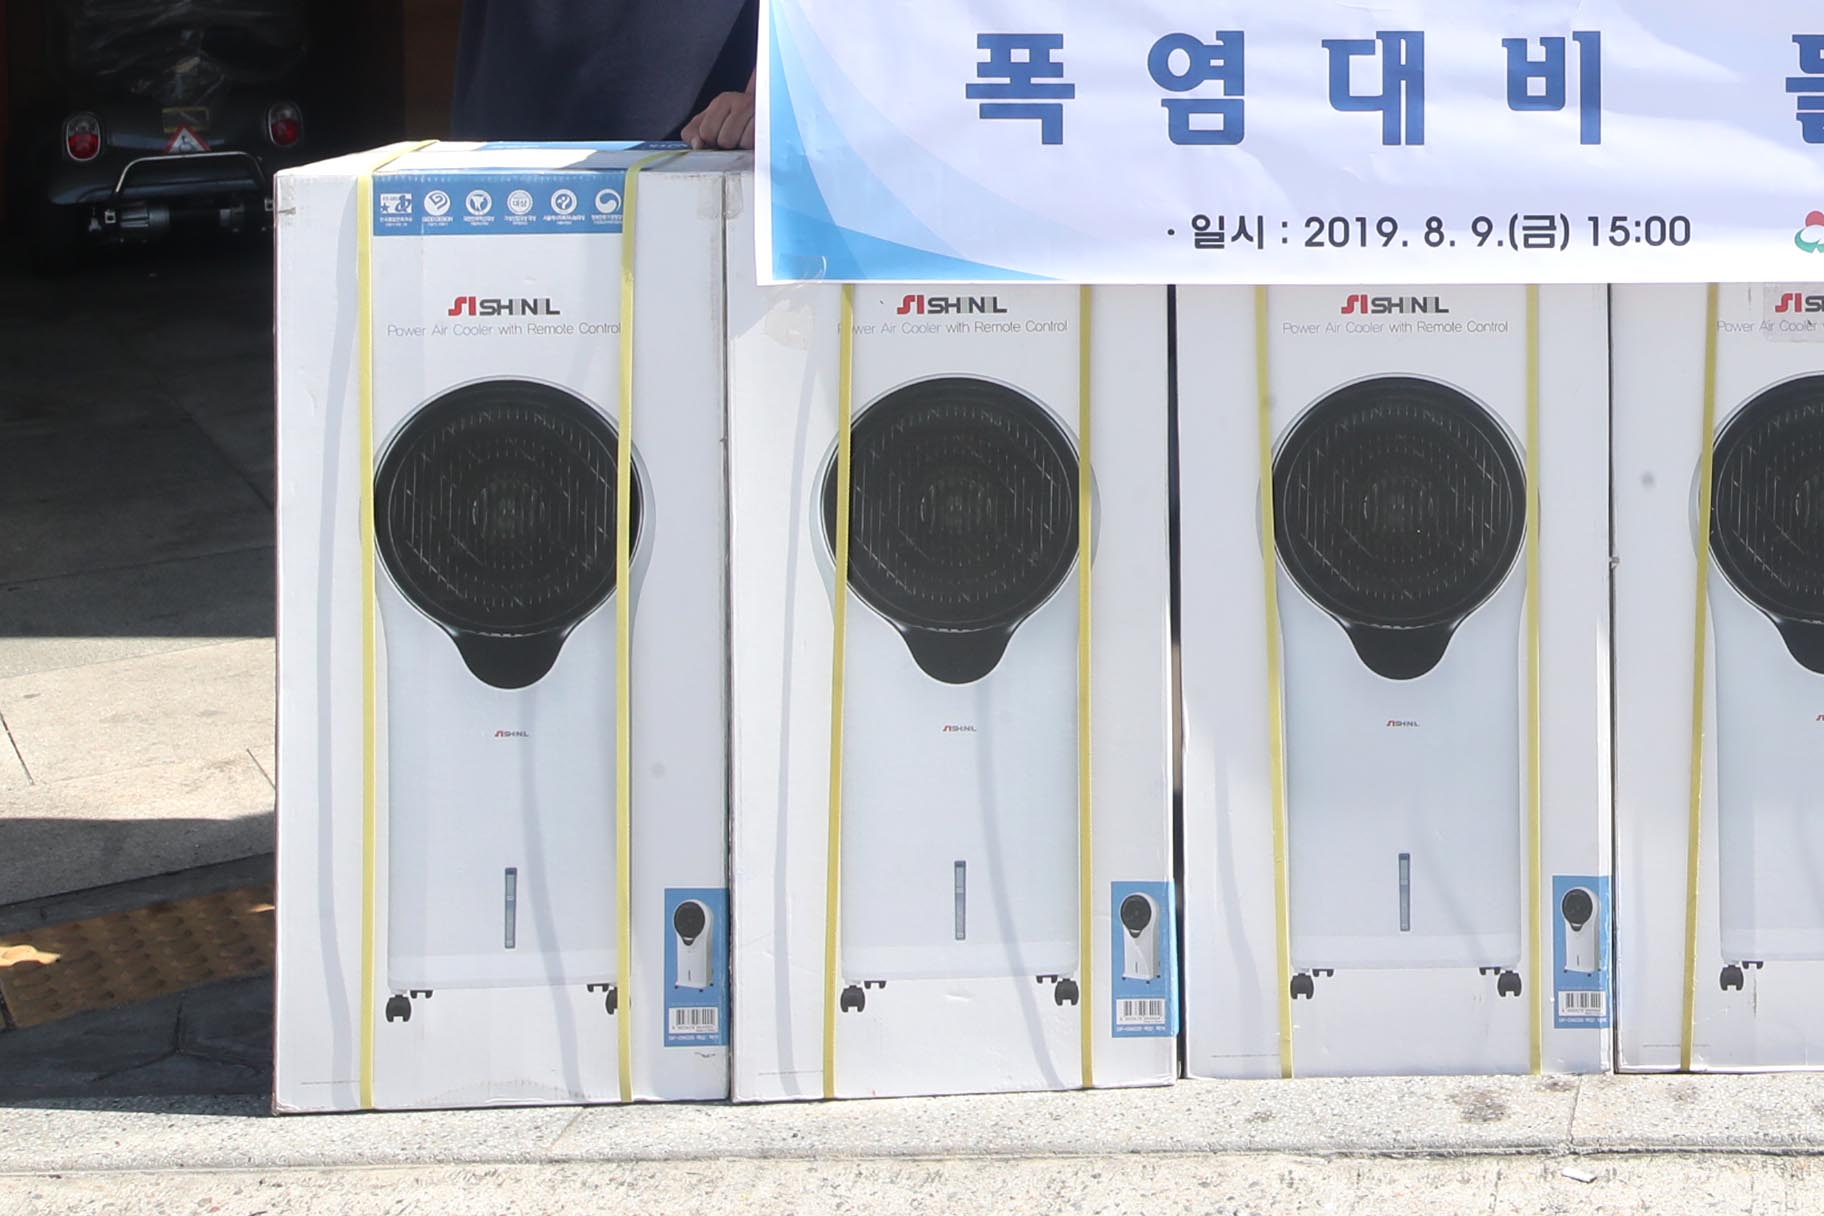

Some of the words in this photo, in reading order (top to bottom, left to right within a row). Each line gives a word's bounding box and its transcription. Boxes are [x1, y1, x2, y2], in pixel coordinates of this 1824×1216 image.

[1190, 215, 1266, 250] 일시
[1304, 214, 1410, 250] 2019.
[1587, 214, 1692, 249] 15:00
[387, 323, 426, 337] Power
[432, 323, 449, 336] Air
[453, 323, 493, 336] Cooler
[498, 322, 523, 335] with
[527, 322, 574, 335] Remote
[578, 321, 622, 335] Control
[837, 323, 875, 335] Pwer
[881, 323, 896, 334] Air
[902, 322, 940, 334] Cooler
[946, 321, 970, 333] with
[975, 321, 1021, 333] Remote
[1025, 320, 1068, 333] Control
[1282, 322, 1320, 334] Power
[1325, 322, 1341, 333] Air
[1345, 322, 1384, 334] Cooler
[1389, 321, 1413, 333] with
[1417, 321, 1463, 333] Remote
[1466, 320, 1508, 333] Control
[1716, 321, 1754, 333] Power
[1759, 320, 1774, 331] Air
[1780, 320, 1818, 332] Cooler
